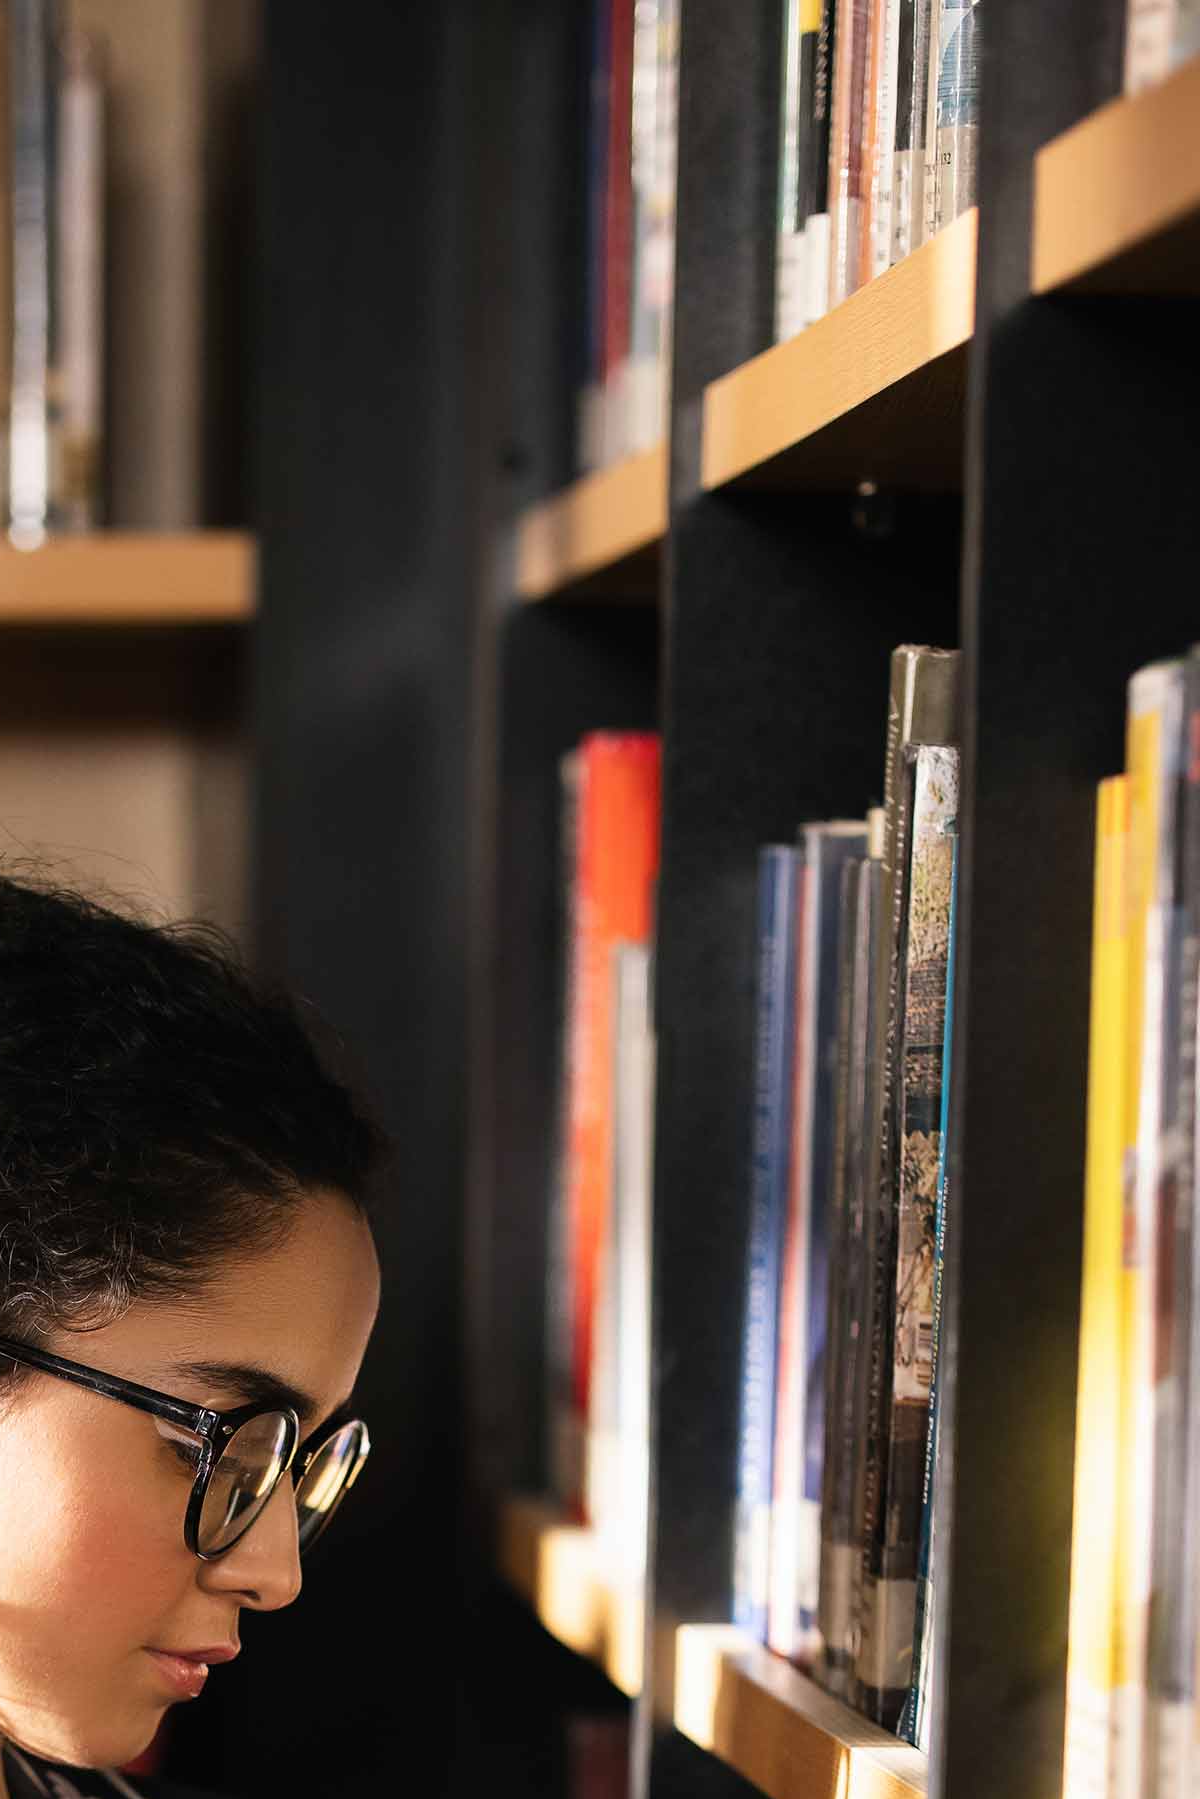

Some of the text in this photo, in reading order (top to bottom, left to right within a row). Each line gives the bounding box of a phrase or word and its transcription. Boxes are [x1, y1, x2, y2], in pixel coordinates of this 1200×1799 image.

[938, 1176, 949, 1250] Muslim
[931, 1257, 943, 1384] Architecture
[922, 1416, 935, 1505] Pakistan
